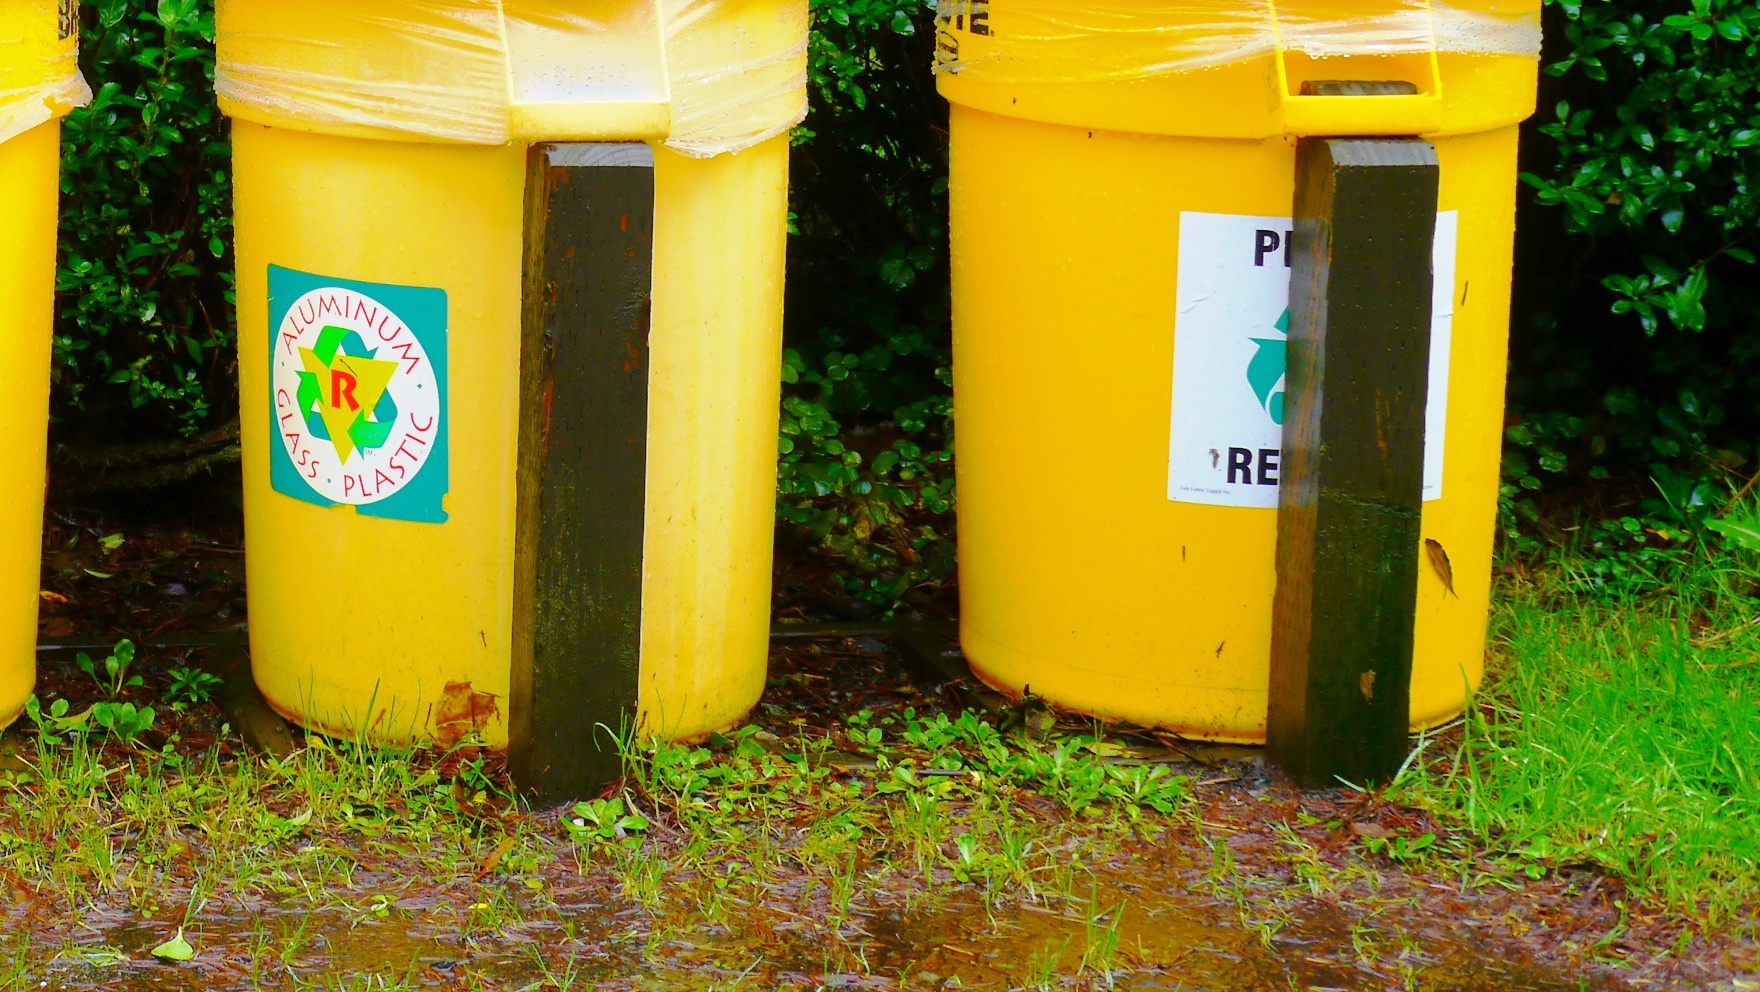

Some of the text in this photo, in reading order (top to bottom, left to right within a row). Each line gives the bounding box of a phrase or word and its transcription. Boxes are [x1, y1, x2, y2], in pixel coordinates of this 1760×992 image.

[282, 295, 421, 375] ALUMINUM
[330, 368, 360, 413] R
[277, 387, 320, 479] GLASS
[342, 411, 433, 498] PLASTIC
